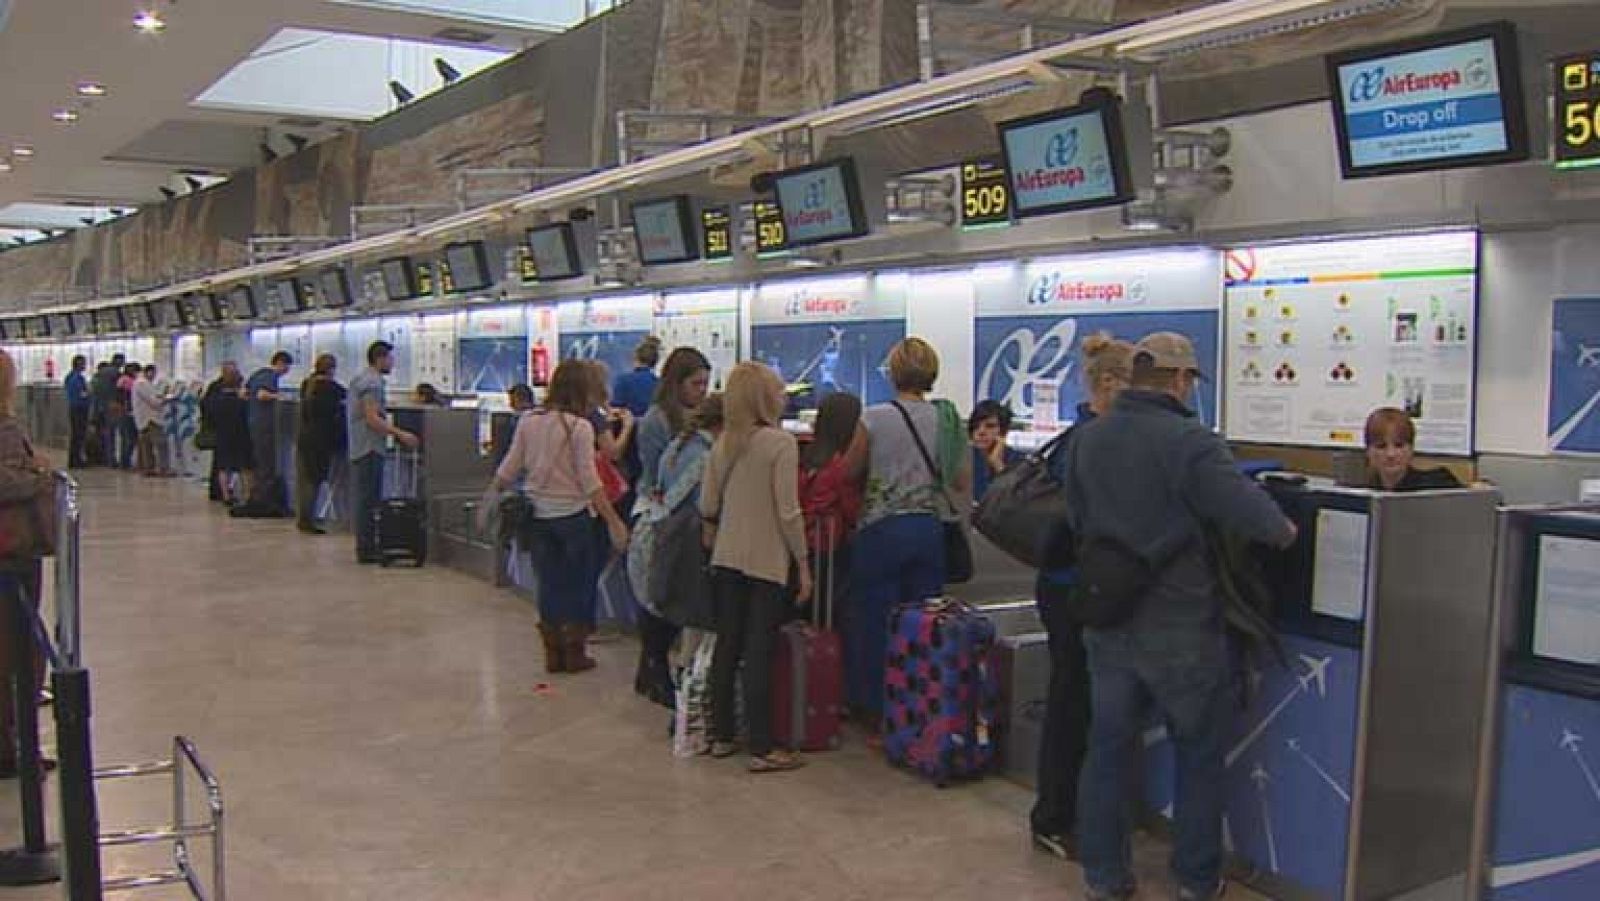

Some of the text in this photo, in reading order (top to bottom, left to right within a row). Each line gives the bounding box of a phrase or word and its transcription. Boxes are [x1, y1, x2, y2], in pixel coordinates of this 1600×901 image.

[1383, 69, 1461, 96] AirEuropa
[1382, 101, 1458, 130] Drop off
[1016, 167, 1085, 191] AirEuropa
[965, 185, 1006, 217] 509
[759, 221, 784, 246] 510
[1056, 281, 1124, 302] AirEuropa
